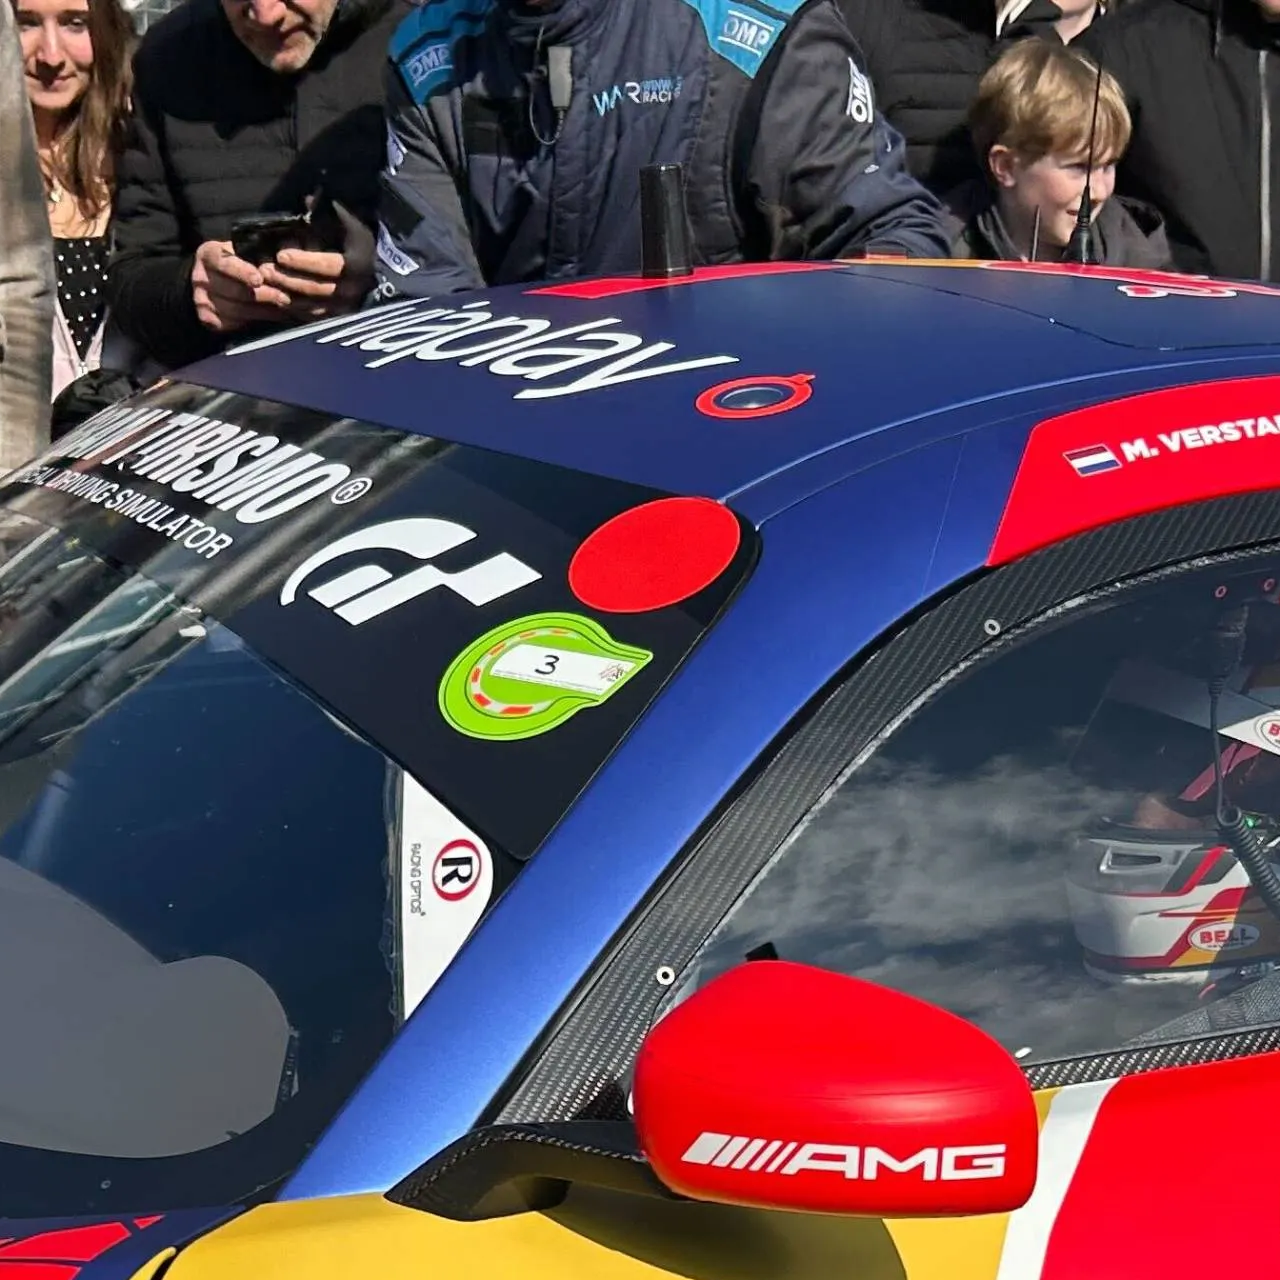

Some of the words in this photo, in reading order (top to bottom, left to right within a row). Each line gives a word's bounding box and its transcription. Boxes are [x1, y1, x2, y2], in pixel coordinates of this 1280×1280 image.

[724, 17, 773, 50] OMP
[409, 48, 451, 84] OMP
[316, 301, 739, 400] viaplay
[1122, 432, 1154, 462] M.
[45, 470, 121, 504] DRIVING
[105, 488, 234, 560] SIMULATOR
[533, 654, 560, 675] 3
[409, 842, 422, 878] RACING
[409, 879, 422, 914] OPTICS
[781, 1143, 1007, 1181] AMG
